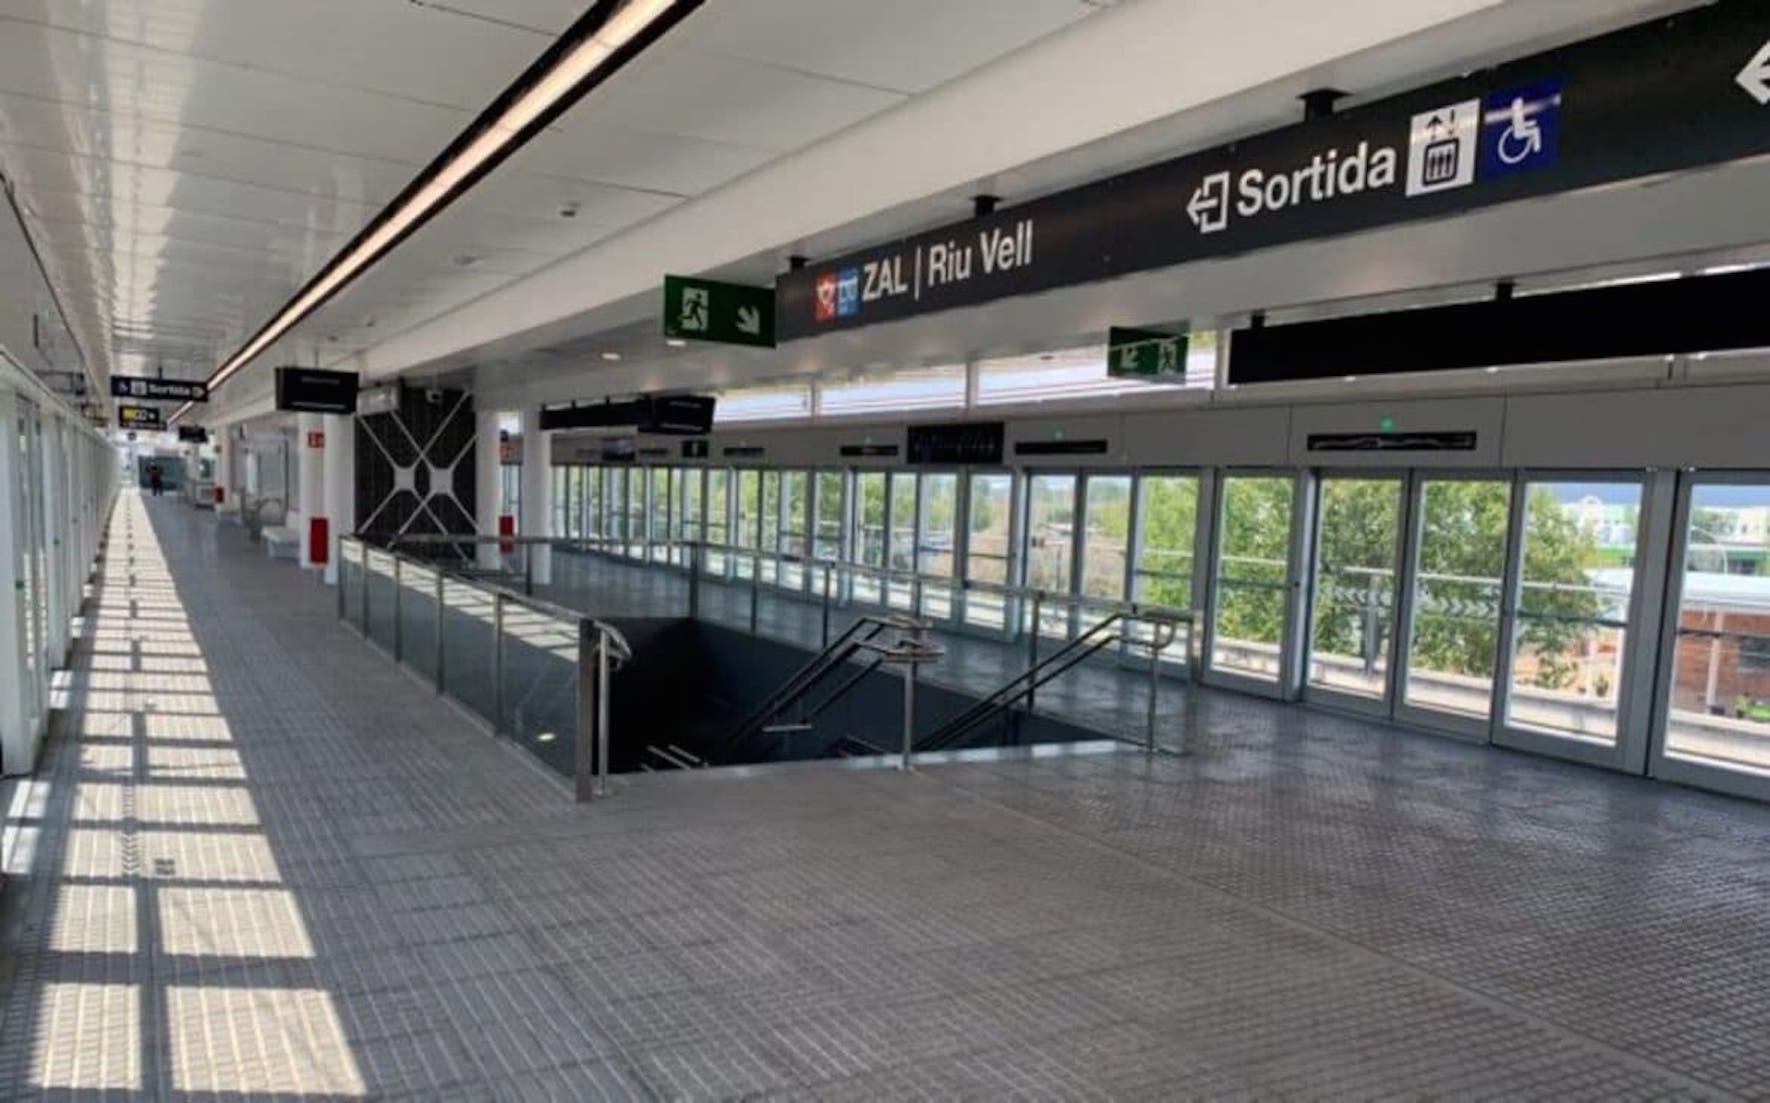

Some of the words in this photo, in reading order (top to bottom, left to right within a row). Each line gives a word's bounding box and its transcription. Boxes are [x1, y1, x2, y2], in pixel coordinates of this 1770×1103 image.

[1236, 140, 1397, 217] Sortida
[862, 254, 909, 301] ZAL
[928, 240, 972, 287] Riu
[979, 219, 1033, 274] Vell
